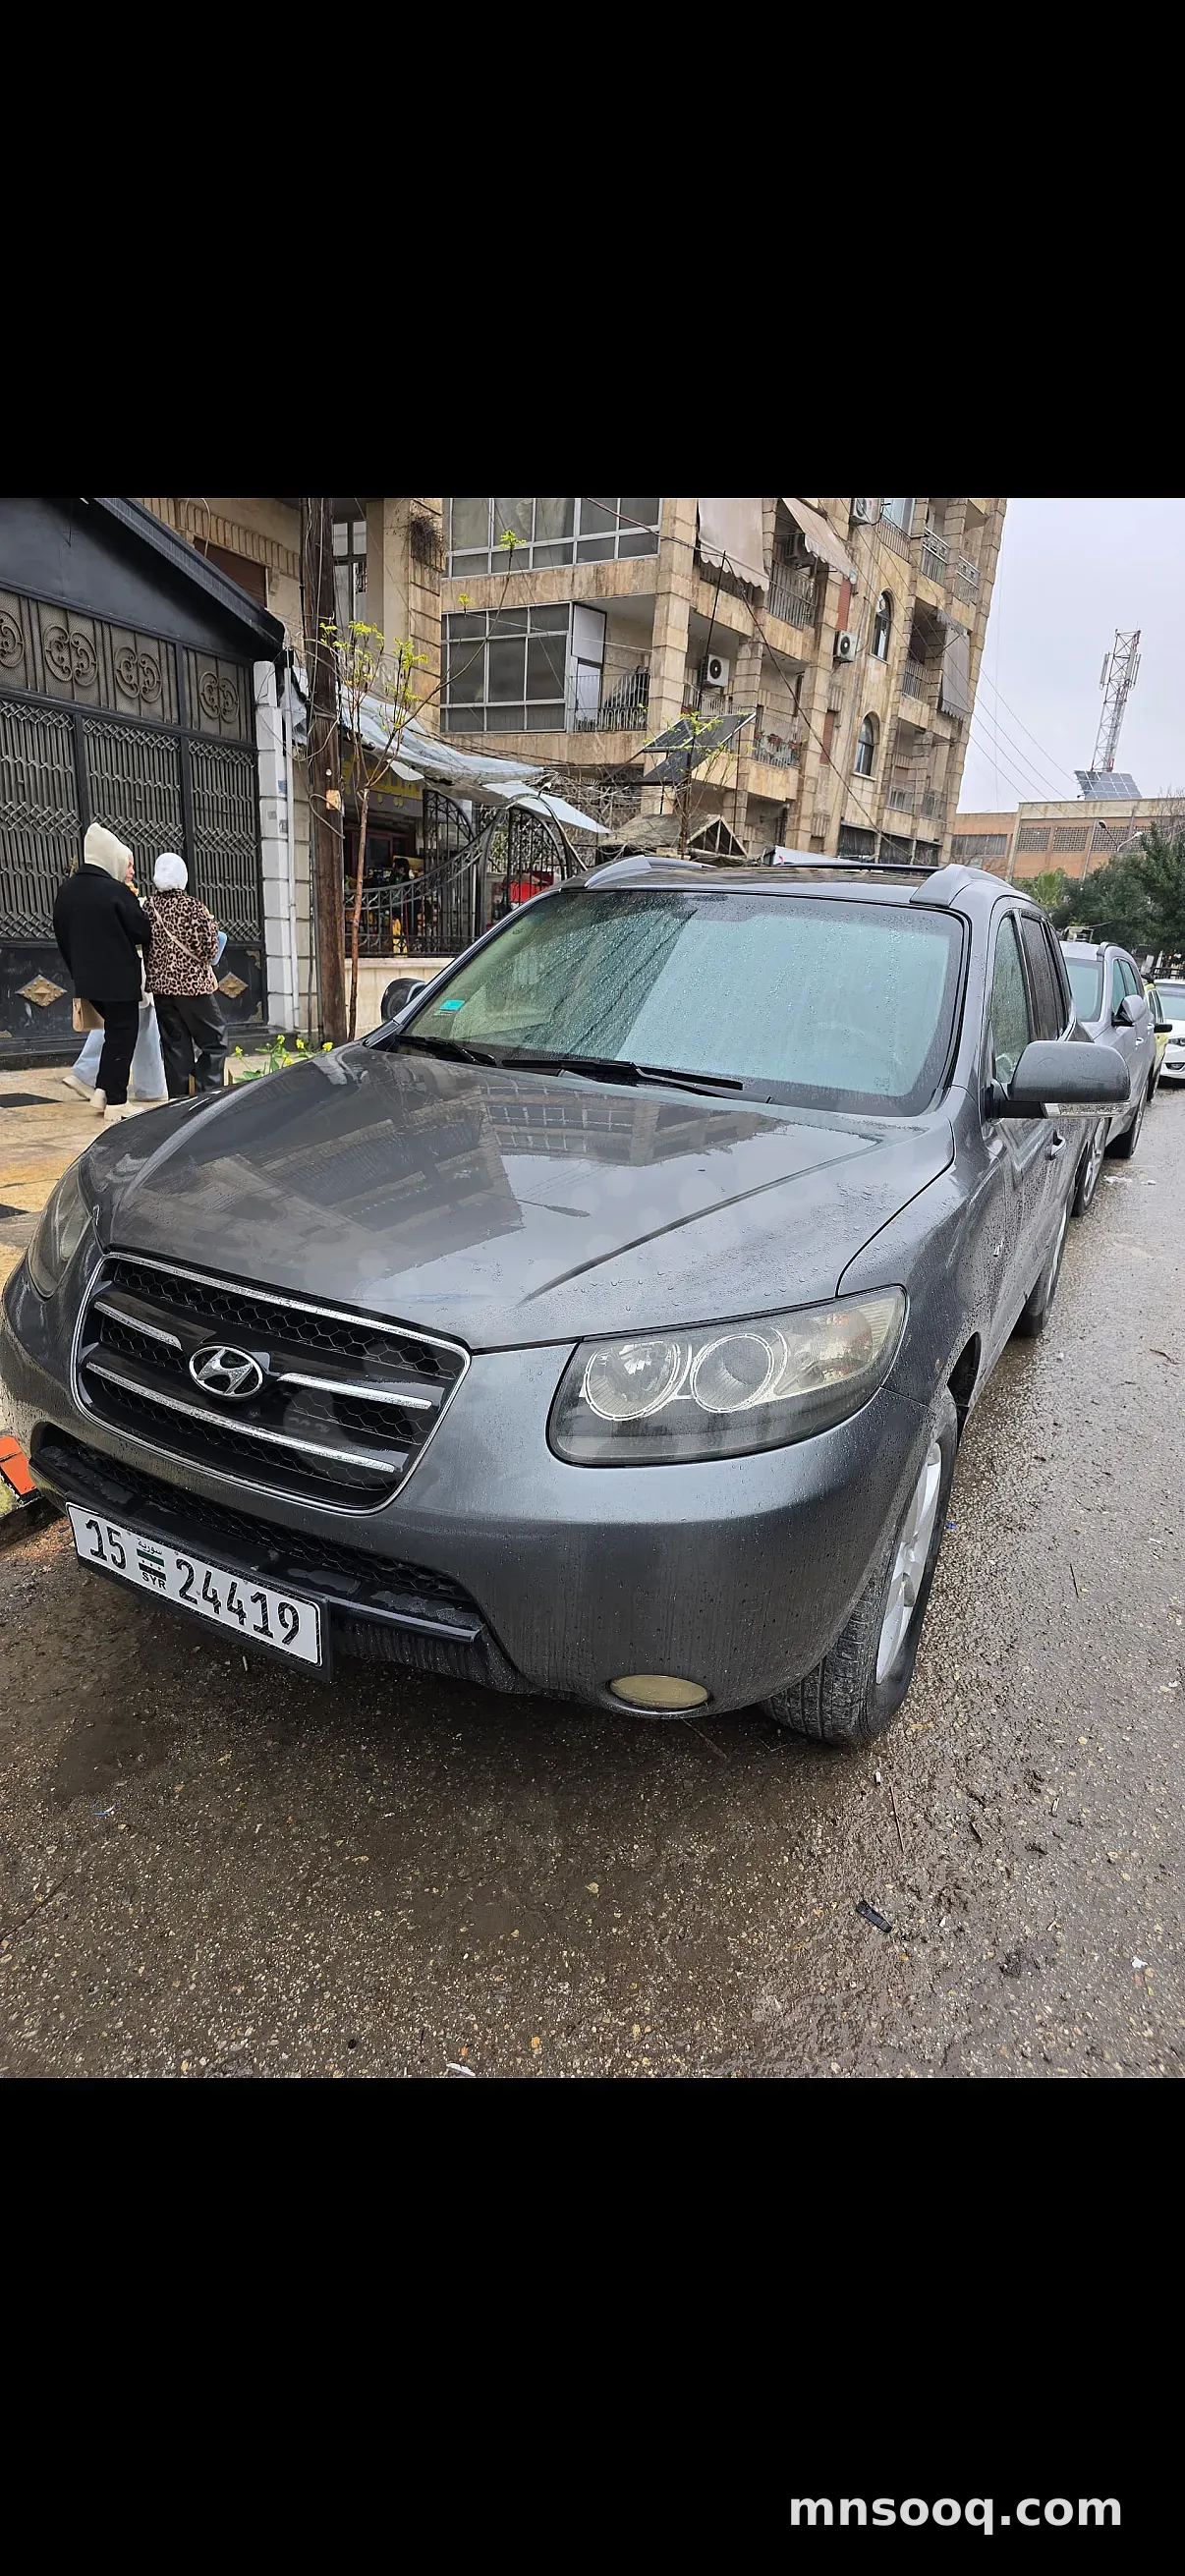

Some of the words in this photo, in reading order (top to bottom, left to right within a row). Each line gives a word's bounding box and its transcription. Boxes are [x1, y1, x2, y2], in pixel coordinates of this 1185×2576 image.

[138, 1537, 163, 1555] سورية
[85, 1519, 127, 1570] 15
[176, 1558, 300, 1646] 24419
[141, 1571, 167, 1591] SYR
